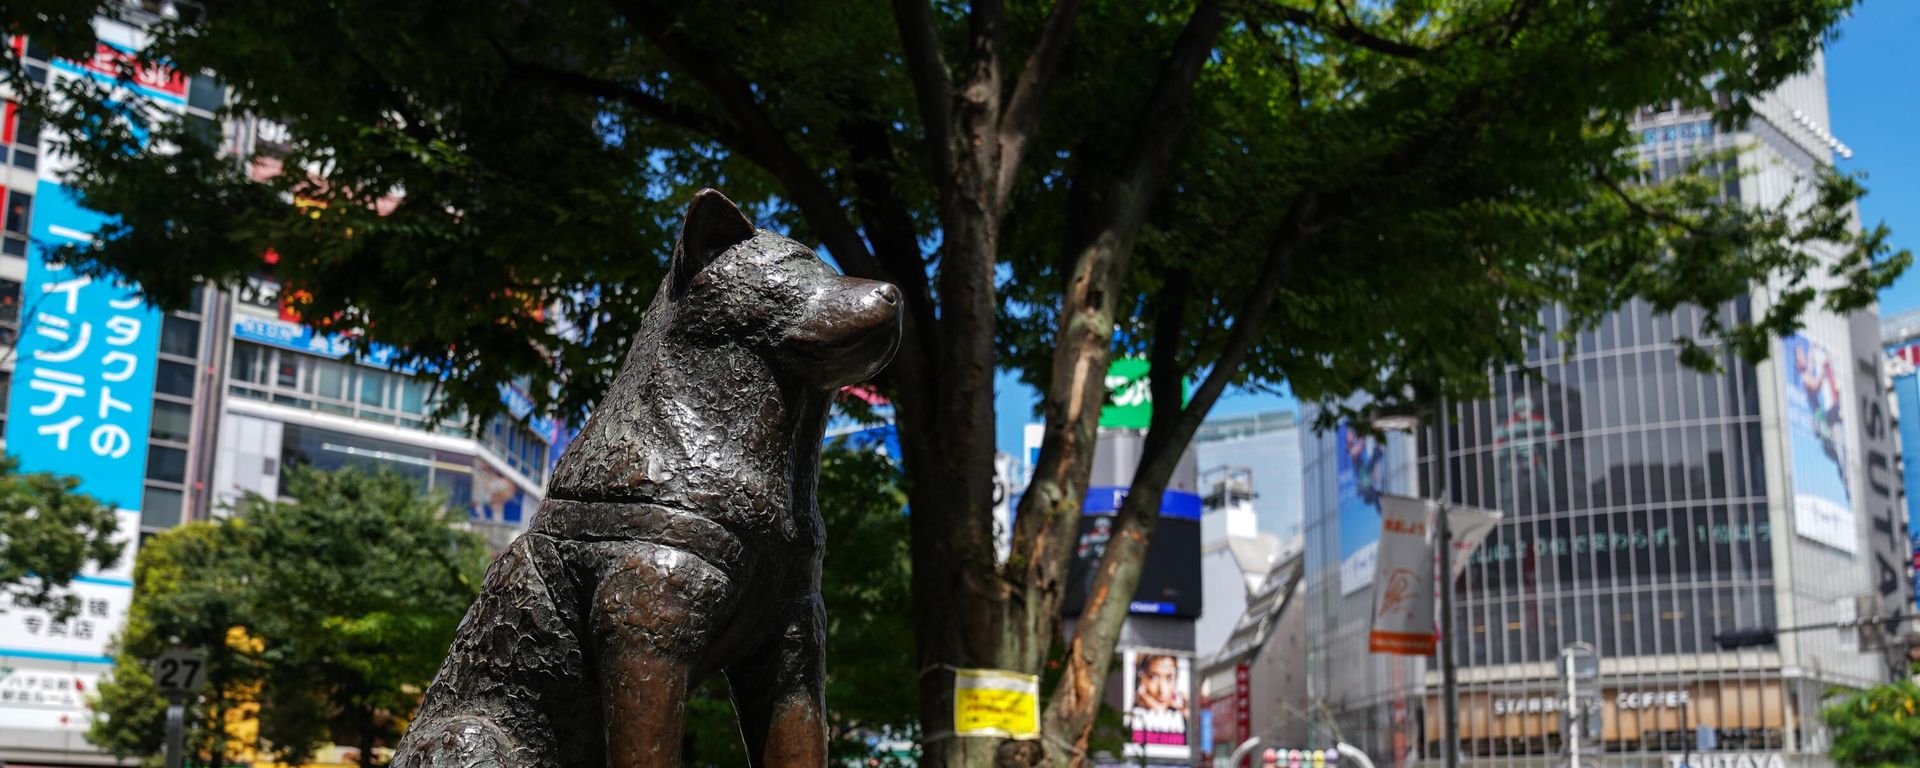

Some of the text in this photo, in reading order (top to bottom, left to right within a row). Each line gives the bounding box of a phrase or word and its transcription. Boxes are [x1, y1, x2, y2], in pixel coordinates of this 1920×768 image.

[159, 657, 201, 689] 27
[1494, 691, 1689, 715] STARBU COFFEE
